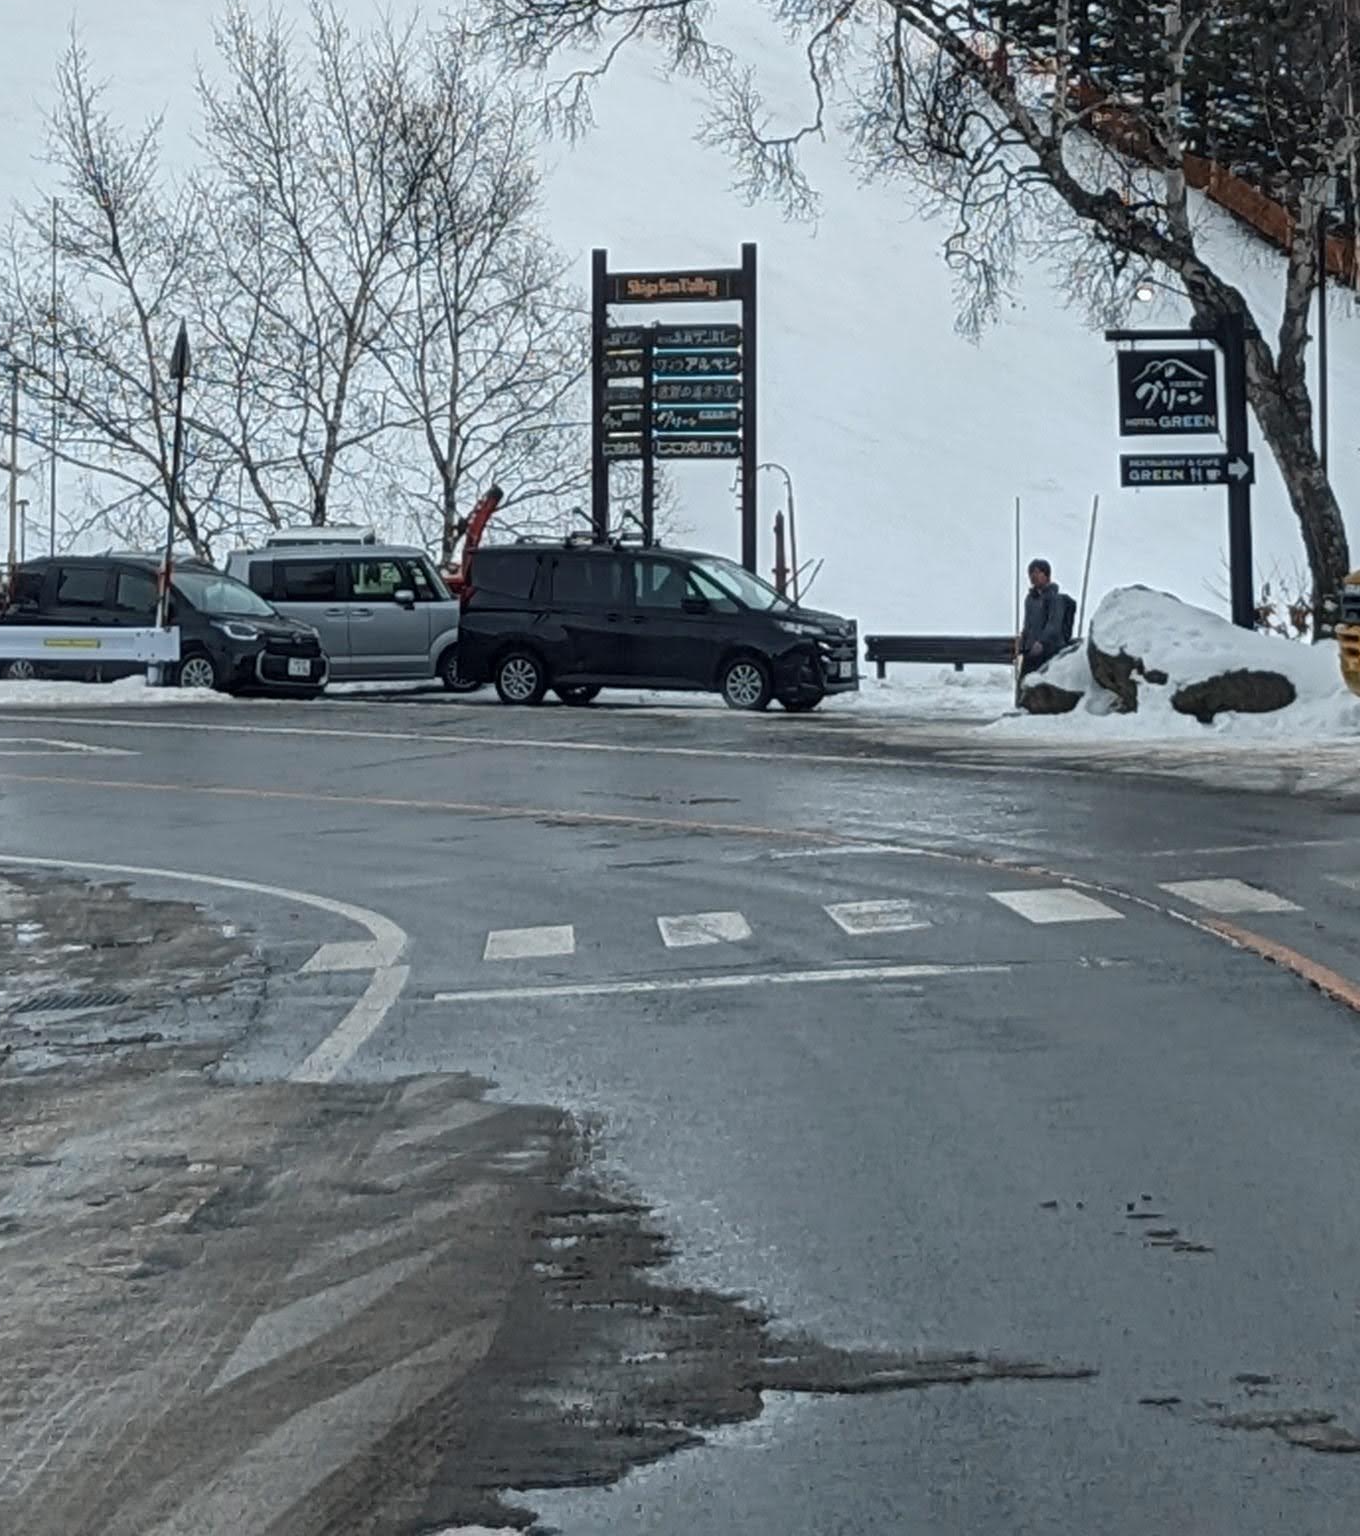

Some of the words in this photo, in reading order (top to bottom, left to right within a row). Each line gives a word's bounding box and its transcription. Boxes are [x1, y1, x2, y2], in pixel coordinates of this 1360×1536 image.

[1135, 380, 1204, 410] グリーン
[1159, 415, 1216, 428] GREEN
[1129, 469, 1185, 481] GREEN
